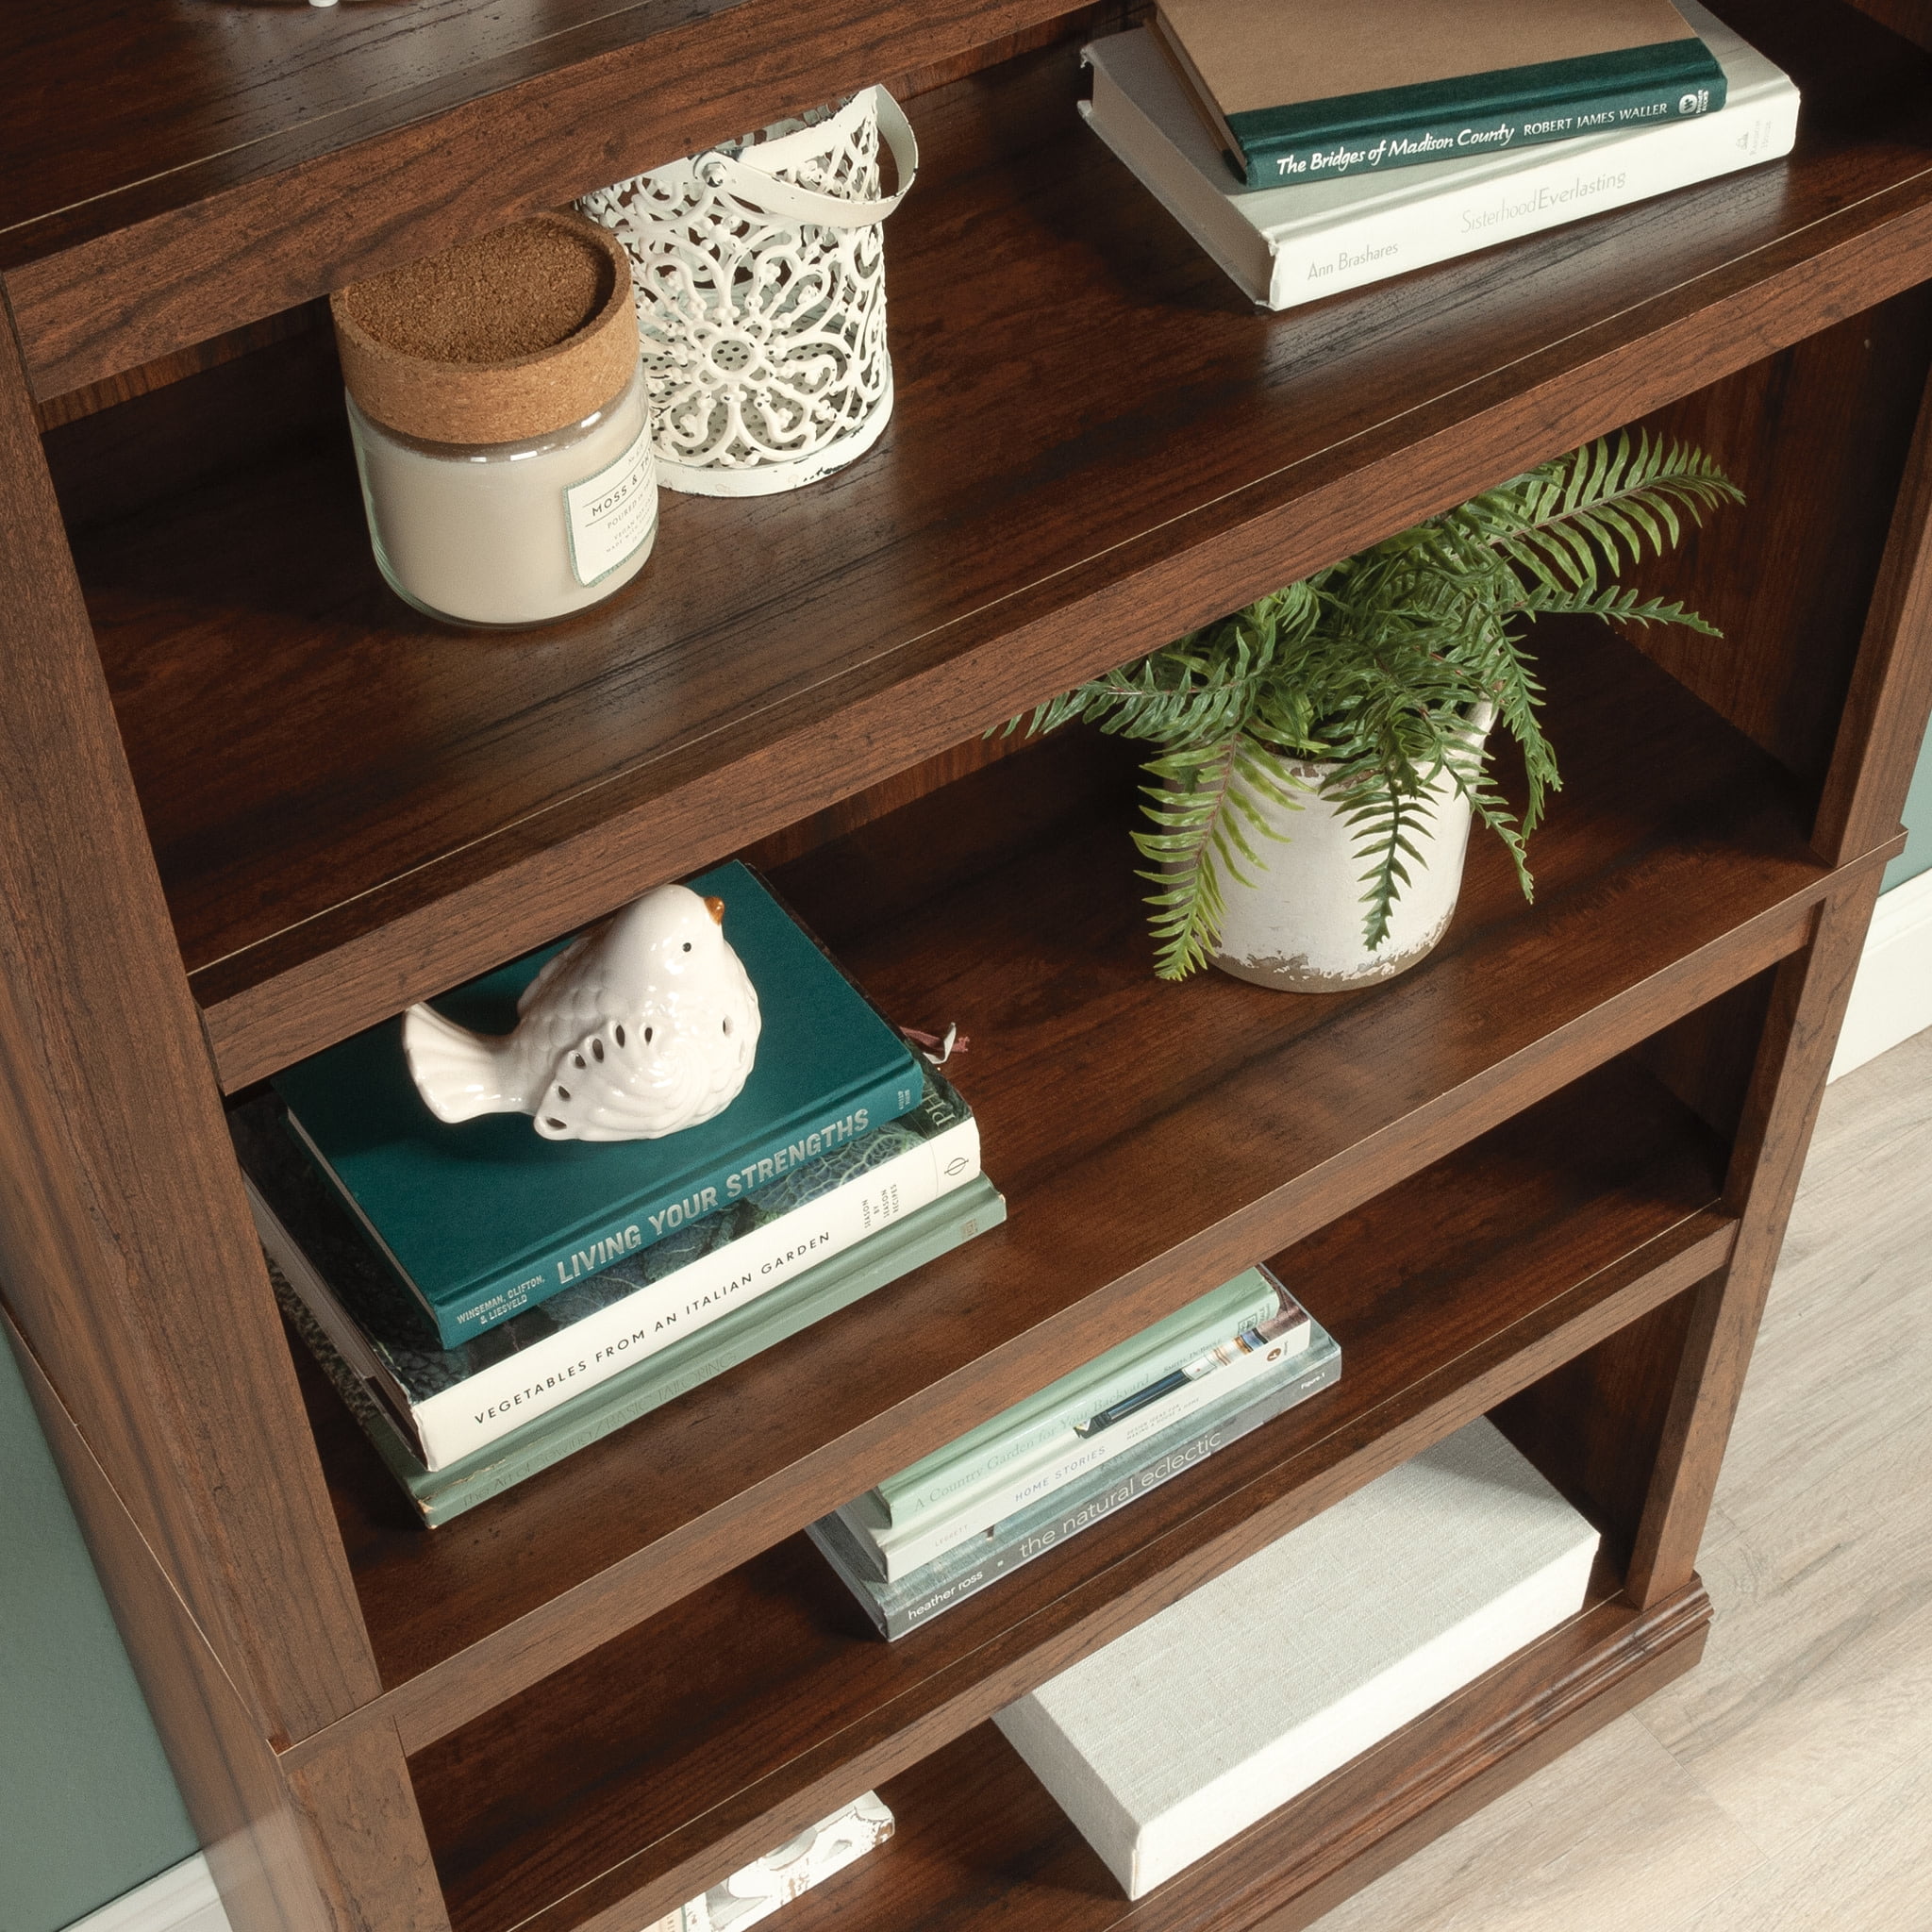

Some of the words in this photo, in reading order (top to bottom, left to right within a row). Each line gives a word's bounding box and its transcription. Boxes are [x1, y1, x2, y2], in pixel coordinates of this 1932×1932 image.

[1524, 118, 1573, 136] ROBERT
[1576, 110, 1615, 129] JAMES
[1619, 103, 1668, 120] WALLER
[1277, 155, 1307, 175] The
[1309, 147, 1365, 172] Bridges
[1368, 141, 1386, 166] of
[1388, 133, 1453, 158] Madison
[1457, 124, 1514, 146] County
[1307, 261, 1334, 280] Ann
[1338, 242, 1398, 272] Brashares
[591, 485, 627, 517] MOSS
[631, 475, 638, 486] &
[607, 499, 637, 529] POURED
[557, 1224, 642, 1284] LIVING
[648, 1186, 718, 1236] YOUR
[725, 1108, 869, 1198] STRENGTHS
[457, 1295, 507, 1324] WINSEMAN,
[507, 1274, 545, 1300] CLIFTON,
[479, 1313, 488, 1324] &
[489, 1293, 528, 1322] LIESVELD
[475, 1360, 587, 1424] VEGETABLES
[595, 1329, 645, 1363] FROM
[655, 1313, 678, 1333] AN
[685, 1273, 753, 1315] ITALIAN
[760, 1231, 831, 1275] GARDEN
[915, 1498, 926, 1511] A
[928, 1468, 985, 1502] Country
[987, 1439, 1035, 1470] Garden
[1038, 1427, 1057, 1444] for
[1014, 1477, 1049, 1503] HOME
[1055, 1445, 1106, 1479] STORIES
[908, 1586, 956, 1621] heather
[958, 1571, 984, 1592] ross
[1019, 1528, 1057, 1558] the
[1062, 1472, 1134, 1535] natural
[1141, 1430, 1222, 1488] eclectic
